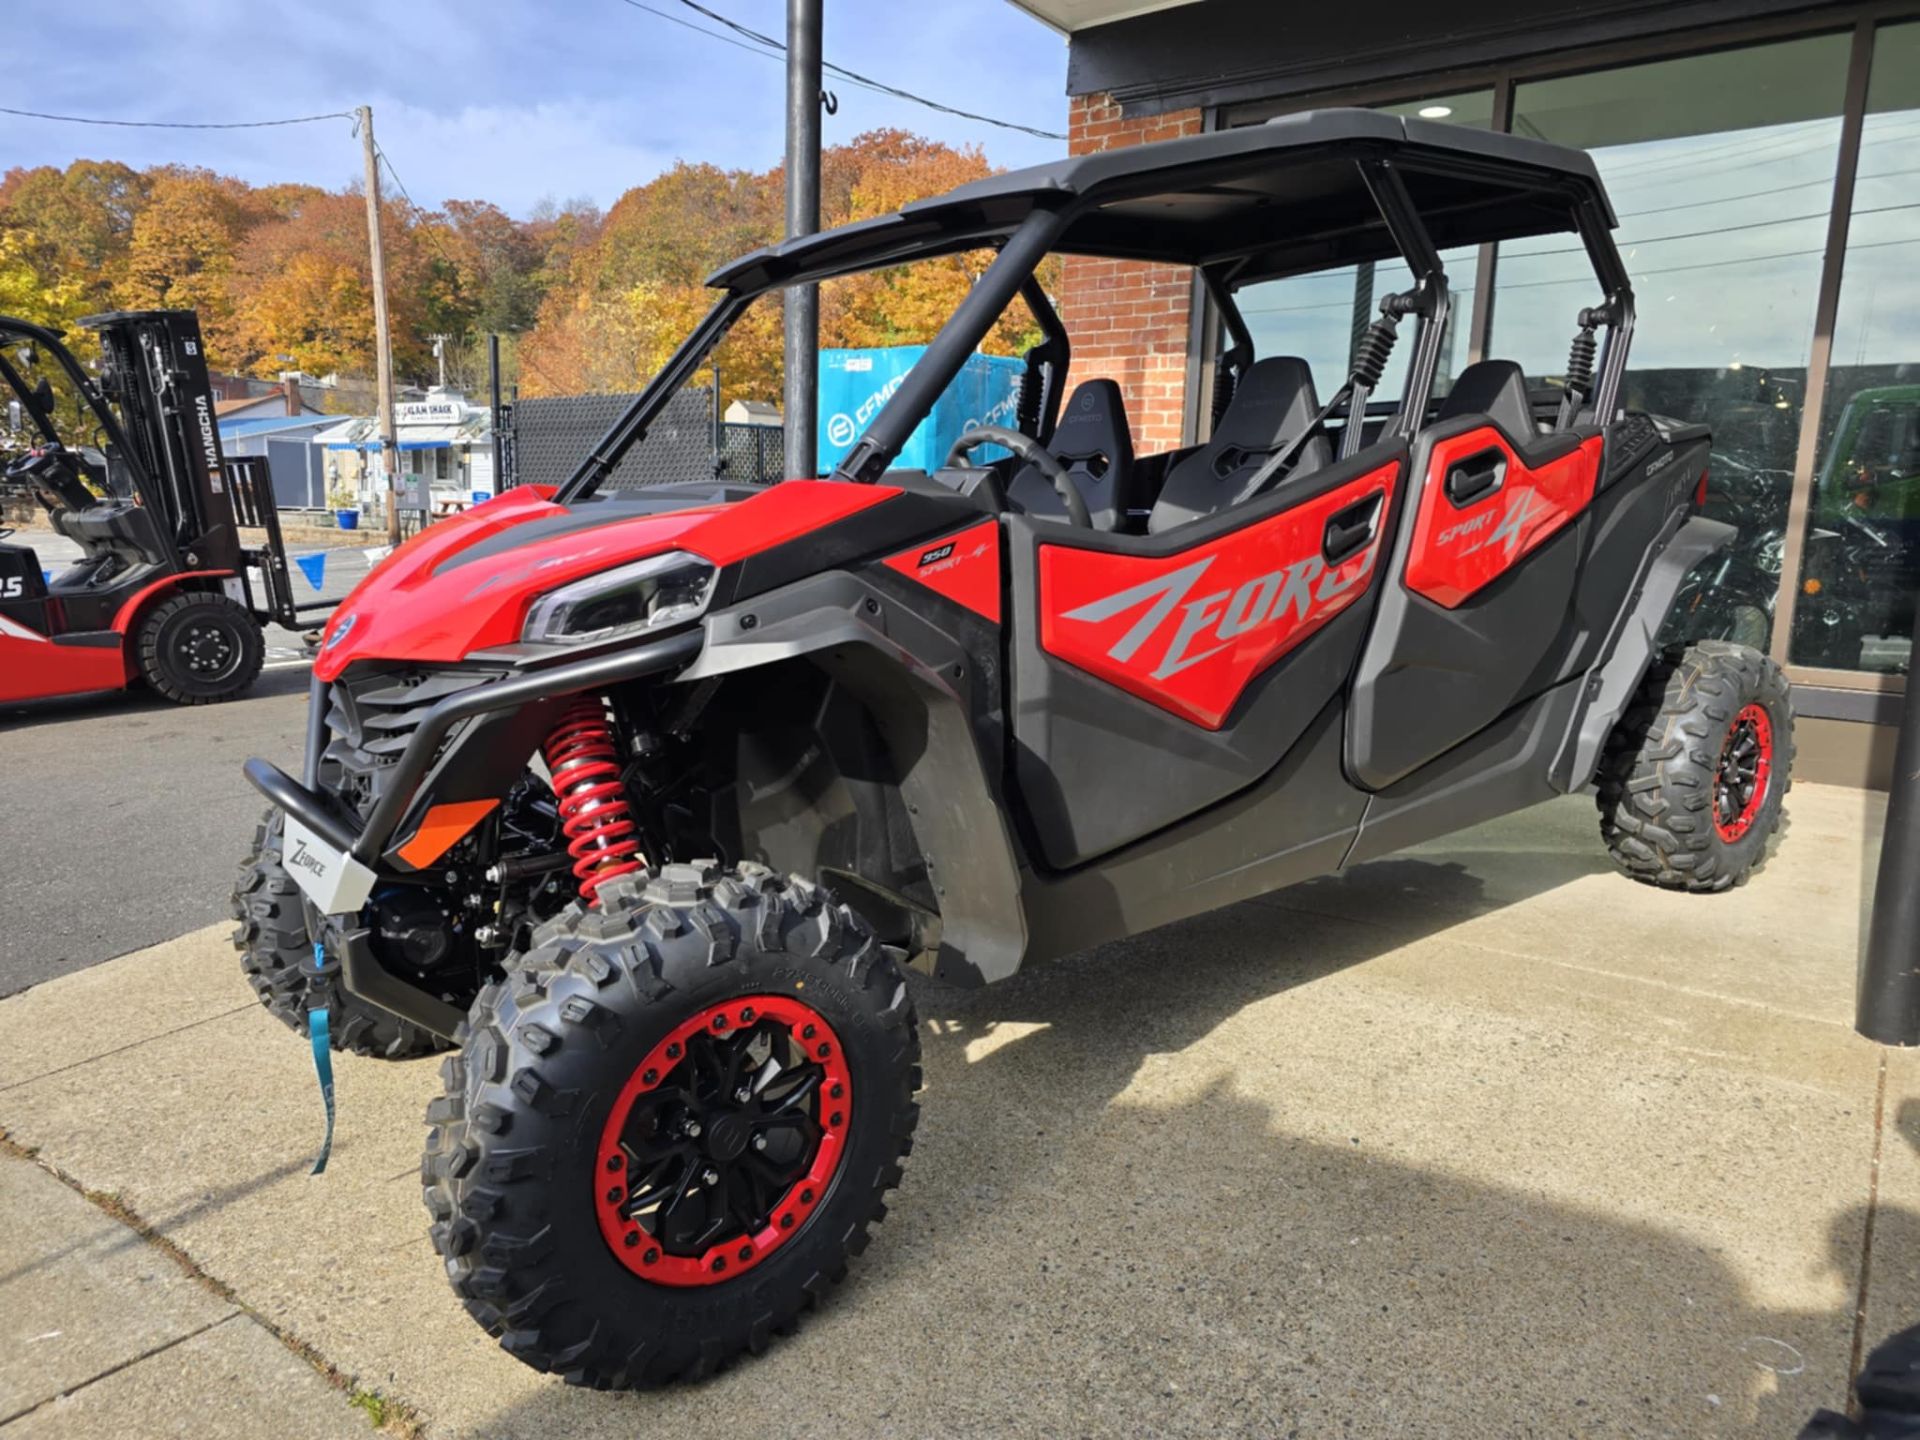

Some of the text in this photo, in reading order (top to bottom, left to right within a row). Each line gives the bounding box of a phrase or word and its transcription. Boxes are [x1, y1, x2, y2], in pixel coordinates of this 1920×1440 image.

[195, 395, 219, 468] HANGCHA
[1437, 509, 1497, 546] SPORT
[920, 546, 953, 564] 950
[290, 839, 327, 877] ZFORCE
